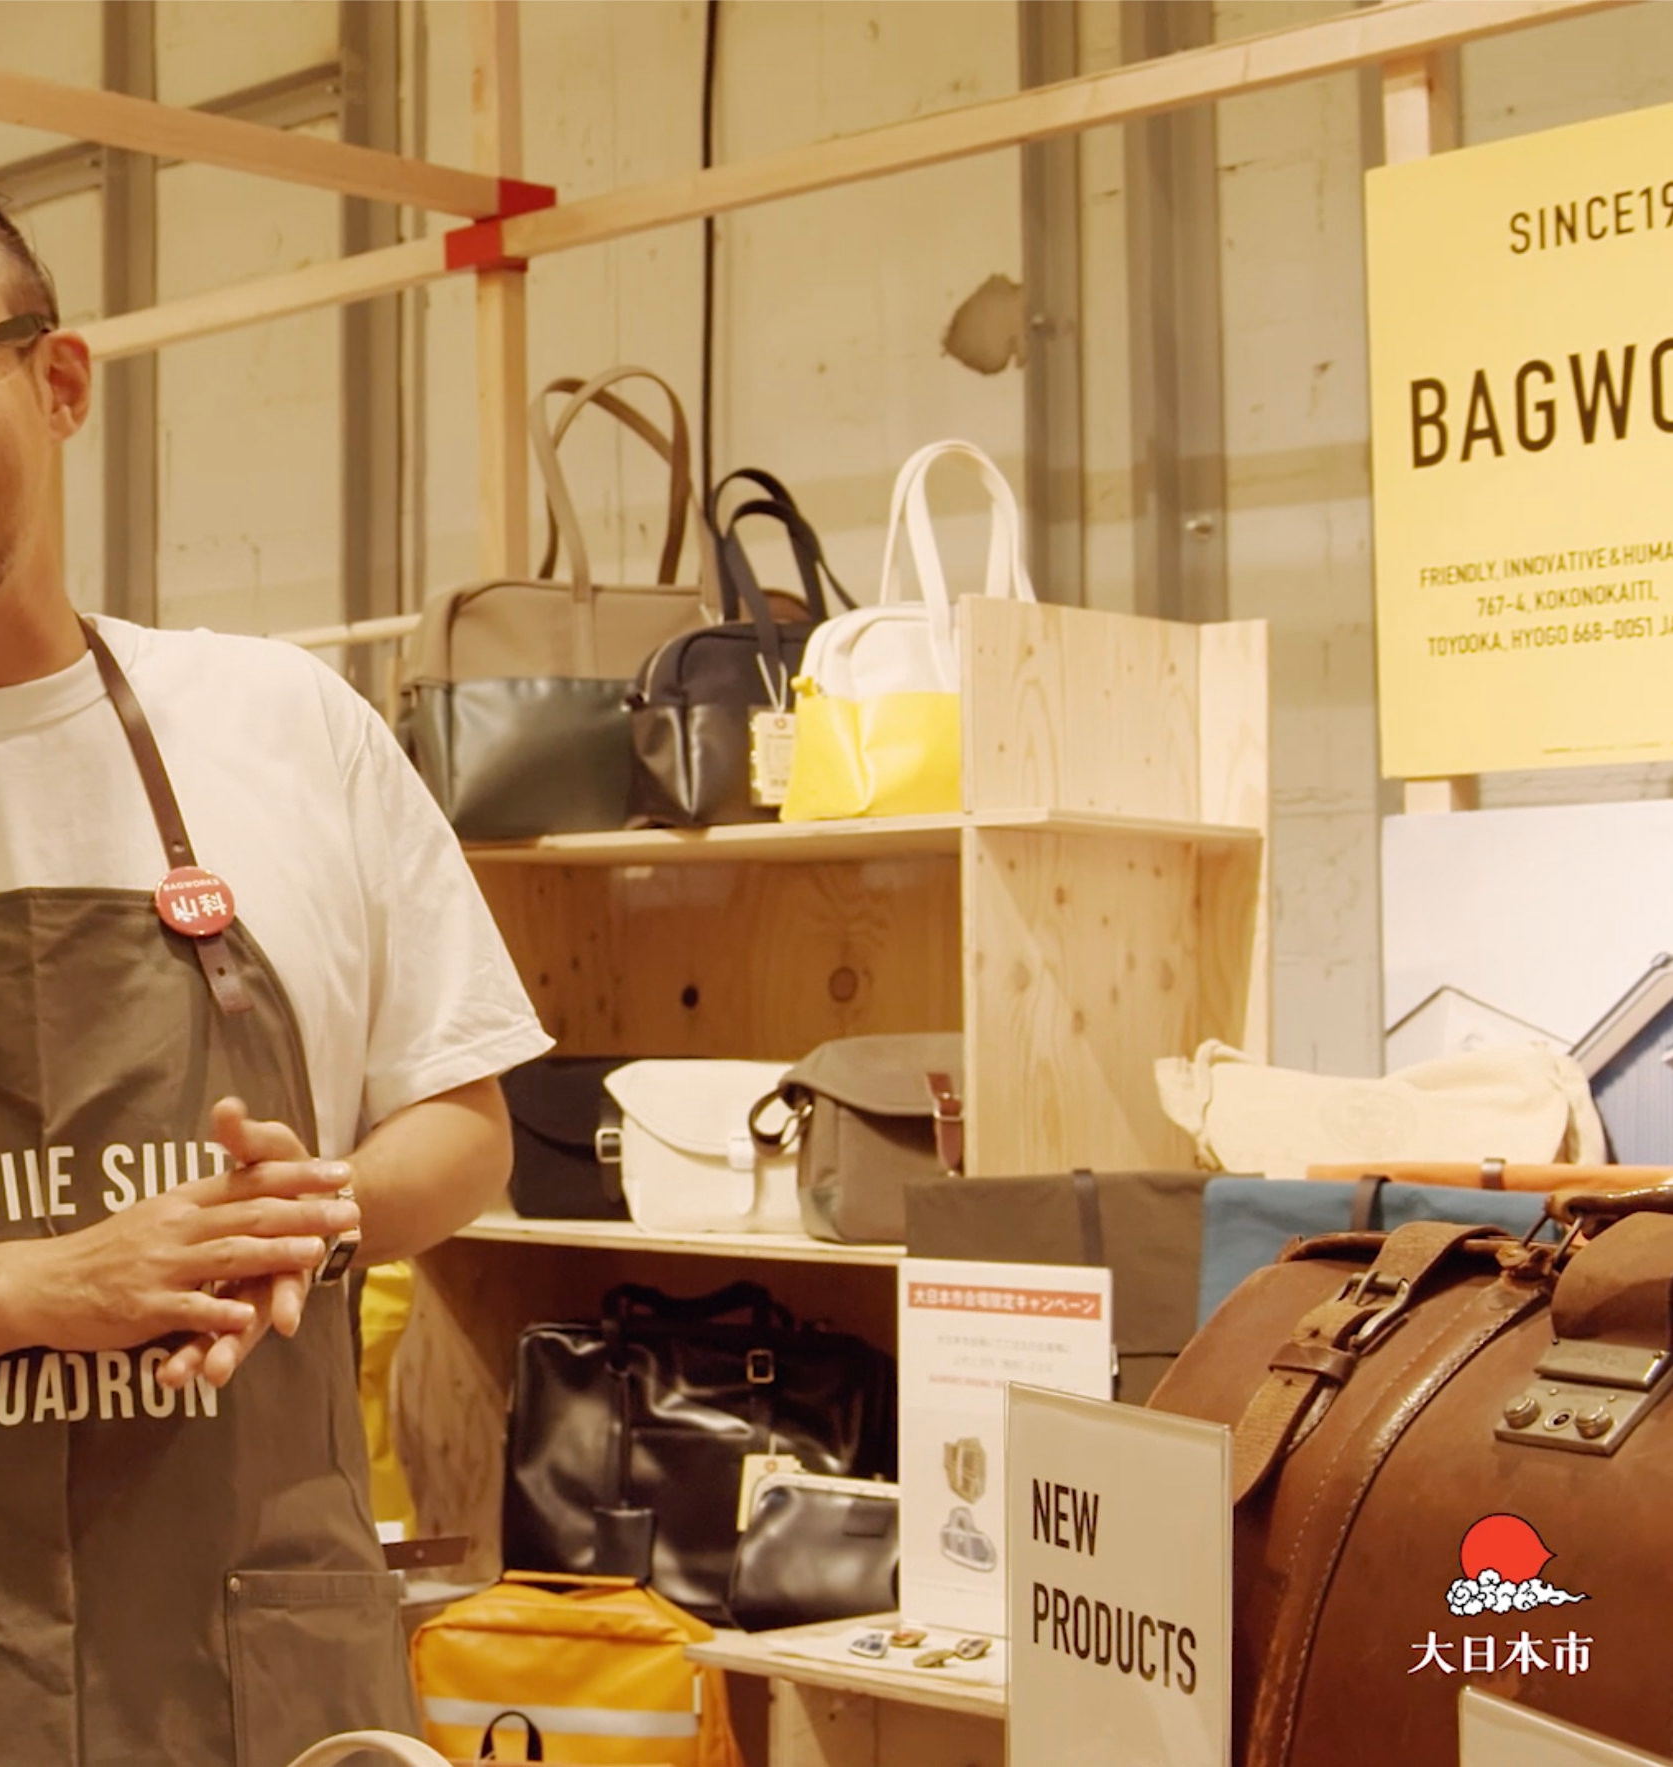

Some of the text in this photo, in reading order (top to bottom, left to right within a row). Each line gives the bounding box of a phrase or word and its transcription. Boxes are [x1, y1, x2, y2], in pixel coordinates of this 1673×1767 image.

[1420, 559, 1501, 588] FRIENDLY,
[1428, 632, 1508, 657] TOYOOKA,
[1512, 624, 1568, 649] HYOGO
[1573, 616, 1653, 643] 668-0051
[1032, 1479, 1099, 1556] NEW
[1033, 1582, 1197, 1695] PRODUCTS
